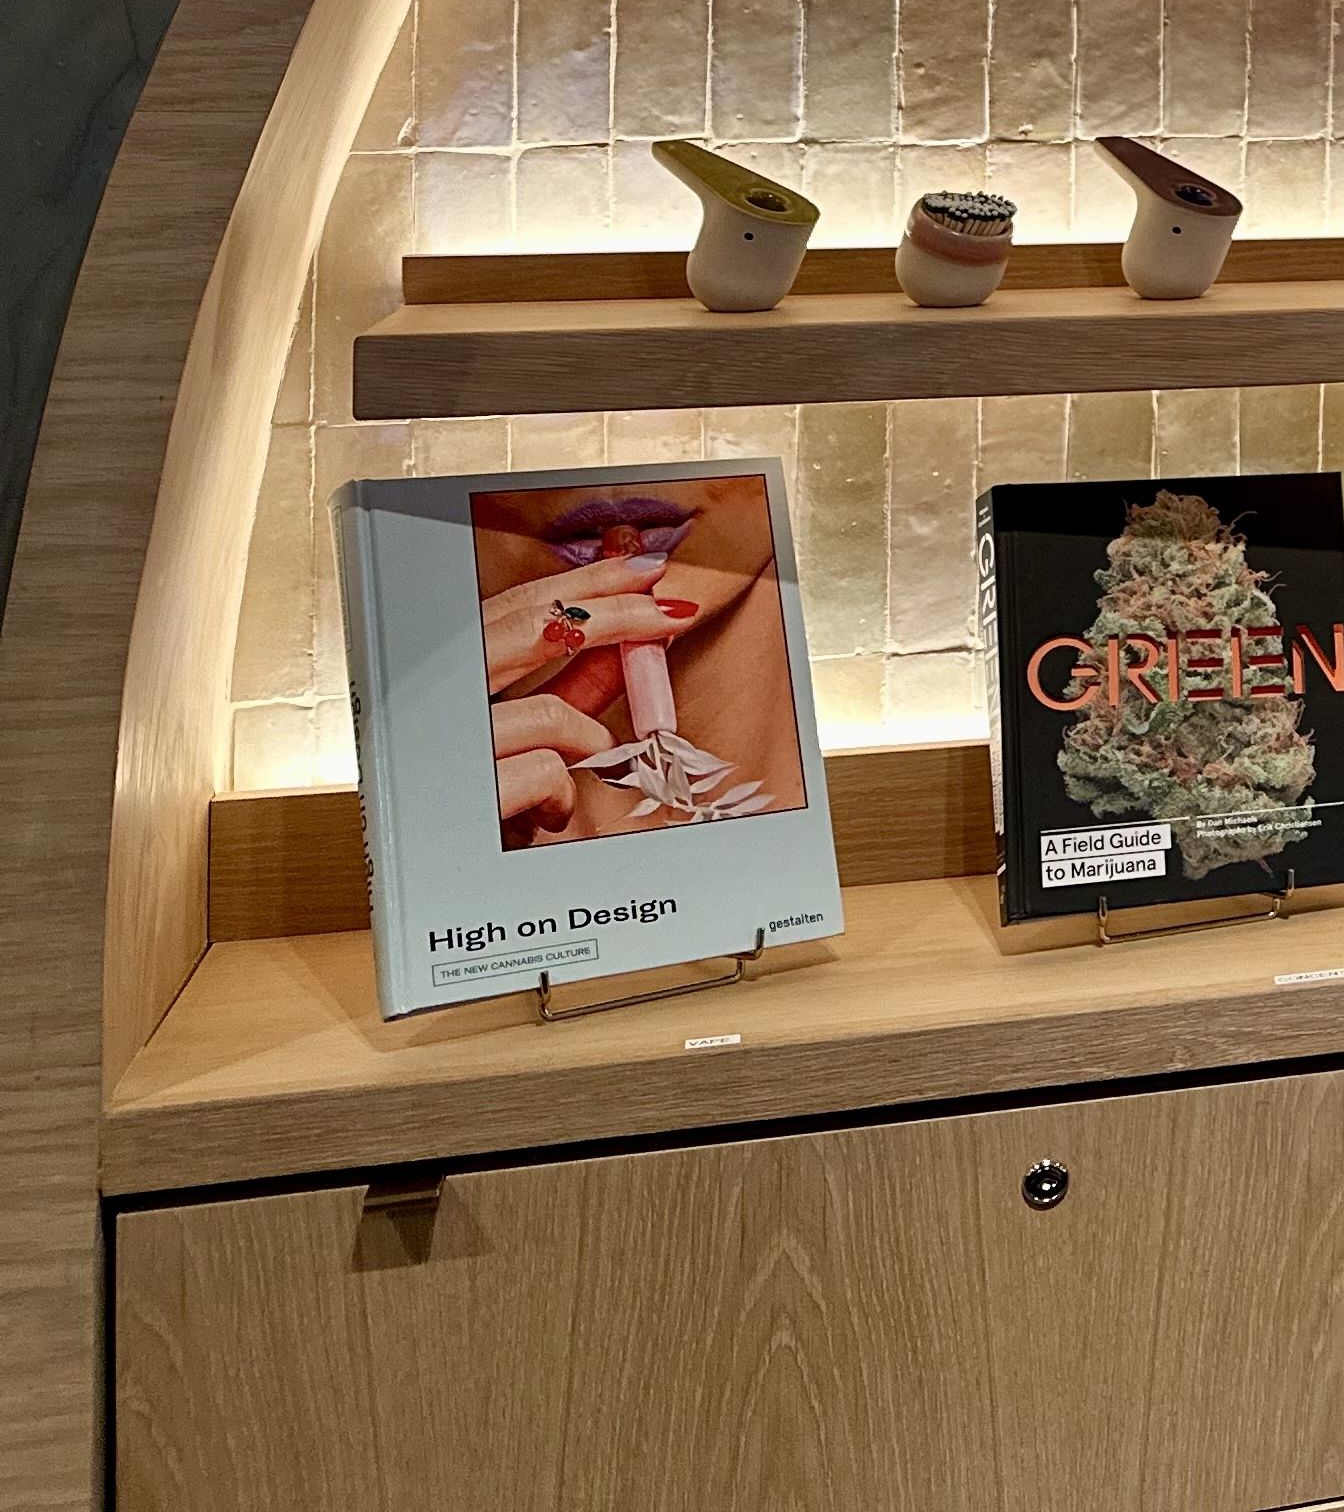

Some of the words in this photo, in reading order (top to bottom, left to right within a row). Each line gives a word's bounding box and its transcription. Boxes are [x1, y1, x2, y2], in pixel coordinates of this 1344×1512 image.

[1045, 840, 1058, 856] A
[1062, 835, 1105, 855] Field
[1109, 831, 1162, 850] Guide
[1045, 865, 1066, 882] to
[1071, 857, 1157, 880] Marijuana
[428, 921, 507, 953] High
[517, 917, 557, 937] on
[568, 898, 678, 930] Design
[769, 912, 824, 932] gestalten
[440, 967, 461, 979] THE
[464, 963, 488, 976] NEW
[490, 954, 543, 971] CANNABIS
[545, 946, 591, 963] CULTURE
